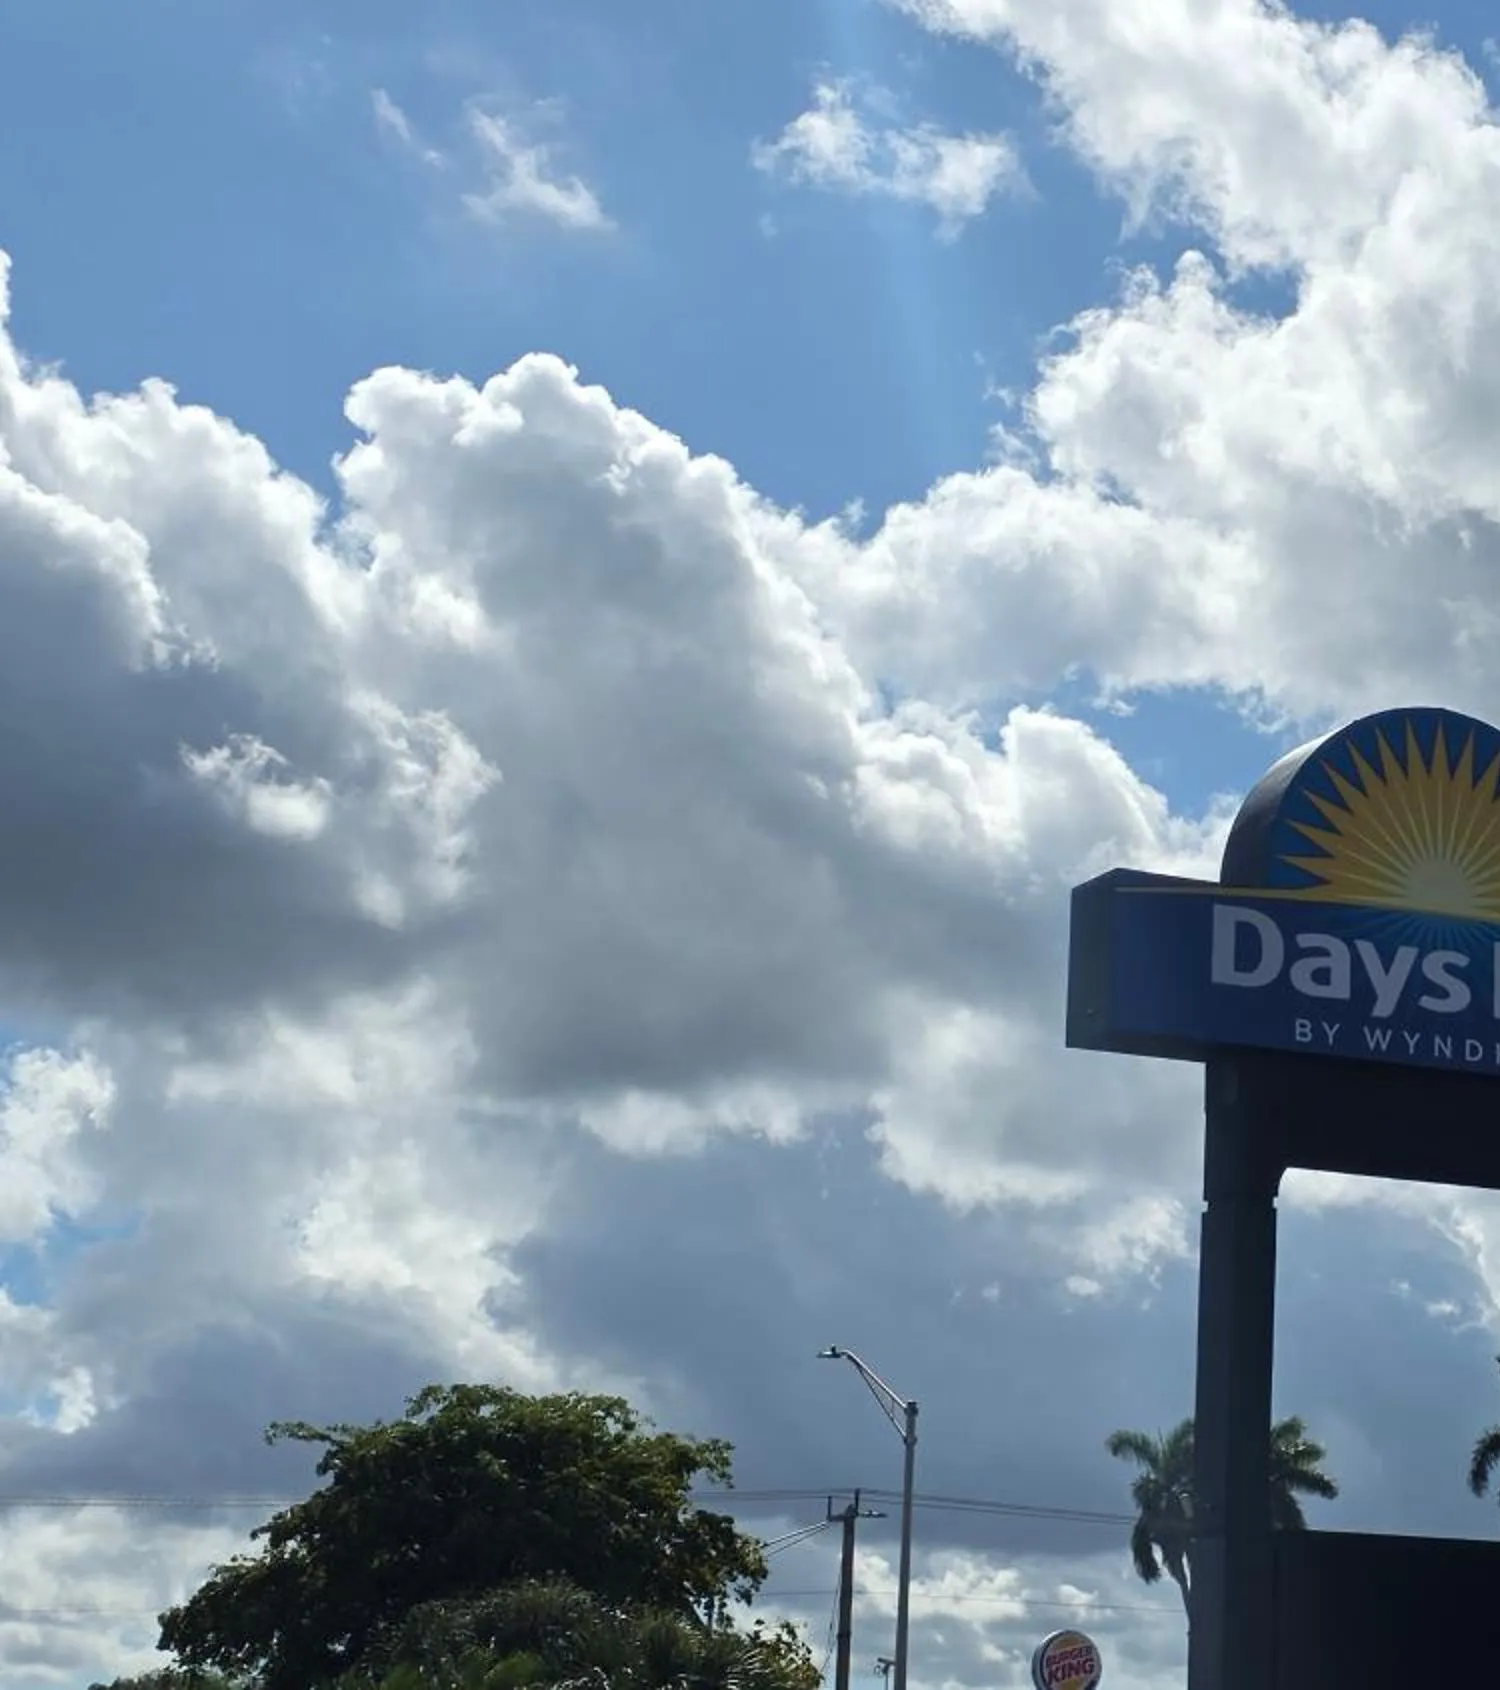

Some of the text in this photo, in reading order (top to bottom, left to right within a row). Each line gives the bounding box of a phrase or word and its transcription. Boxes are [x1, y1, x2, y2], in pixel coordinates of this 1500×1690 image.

[1211, 904, 1471, 1017] Days
[1295, 1019, 1340, 1045] BY
[1046, 1646, 1093, 1667] BURGER
[1047, 1658, 1095, 1685] KING
